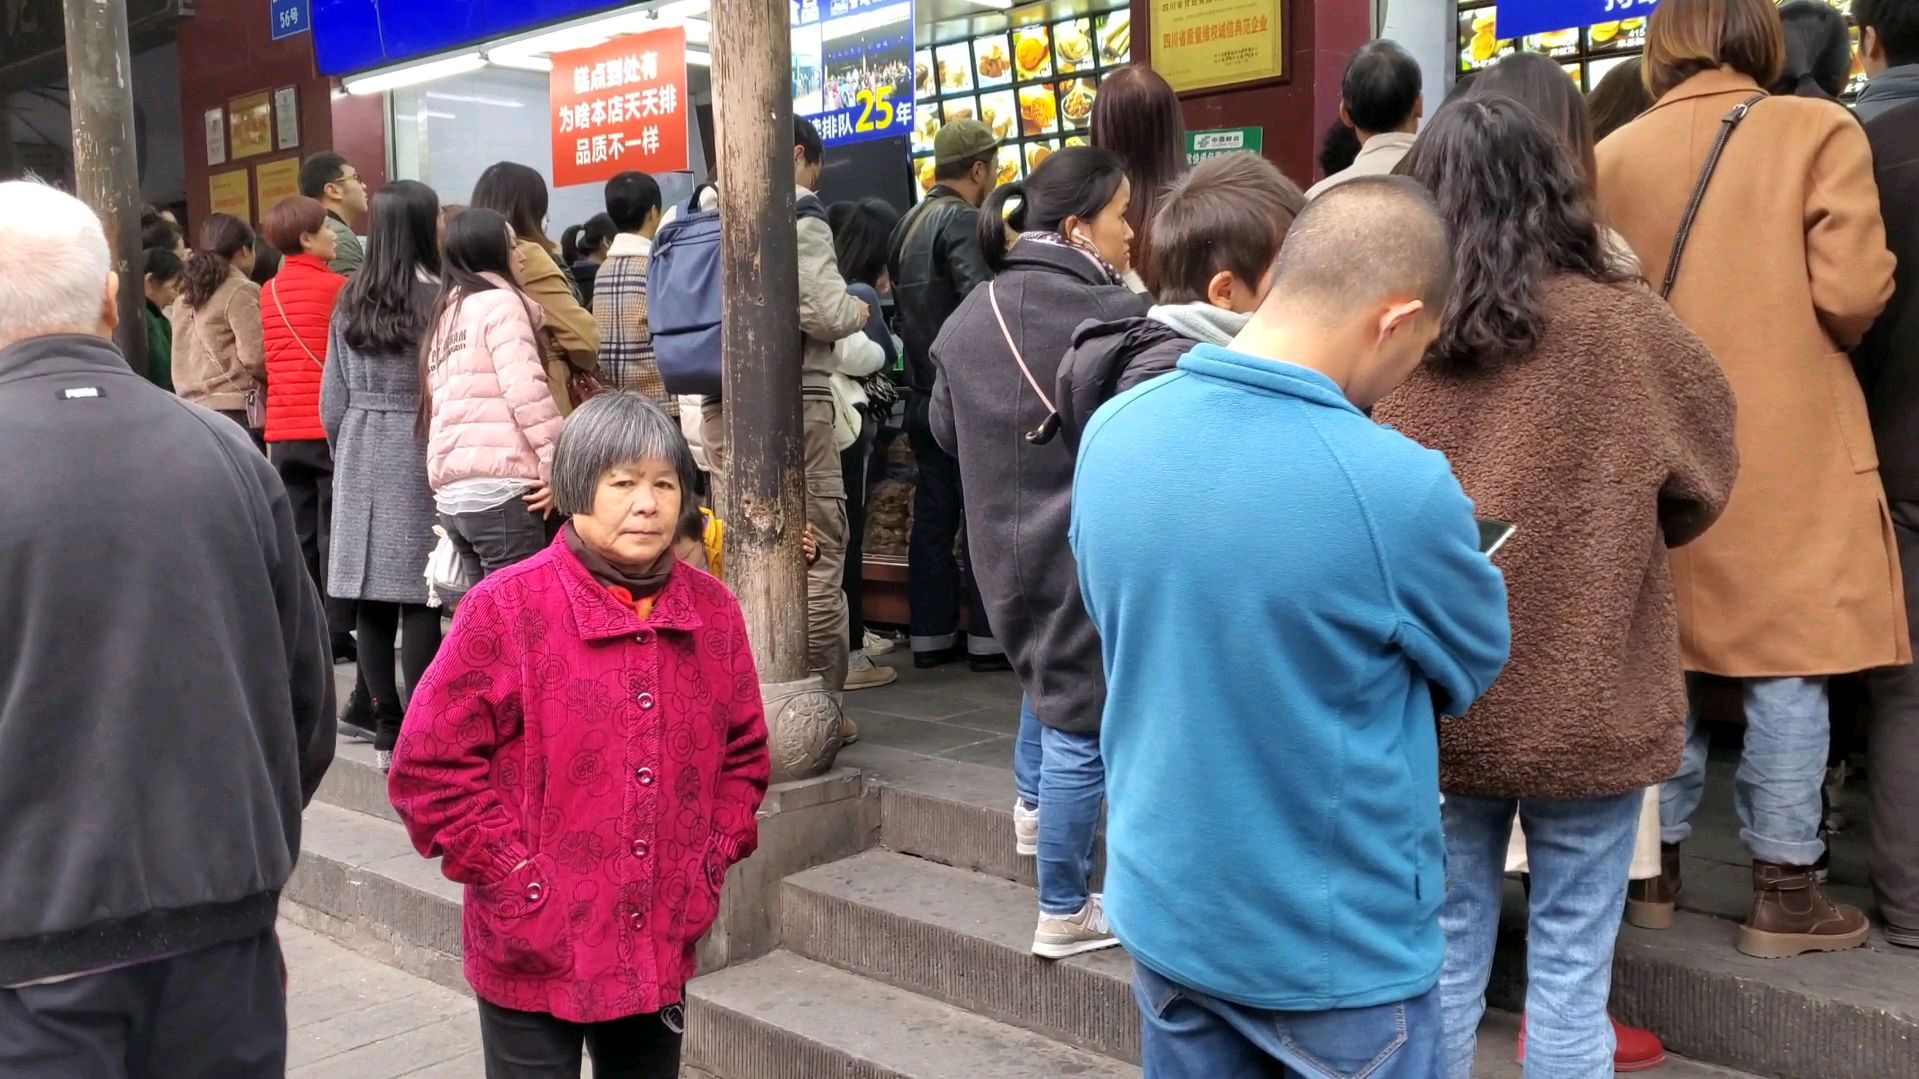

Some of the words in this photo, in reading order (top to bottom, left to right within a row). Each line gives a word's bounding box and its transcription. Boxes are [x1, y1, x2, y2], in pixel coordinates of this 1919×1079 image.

[280, 7, 298, 28] 56号
[573, 50, 658, 94] 糕点到处有
[559, 83, 677, 133] 为啥本店天天排
[575, 124, 660, 166] 品质不一样
